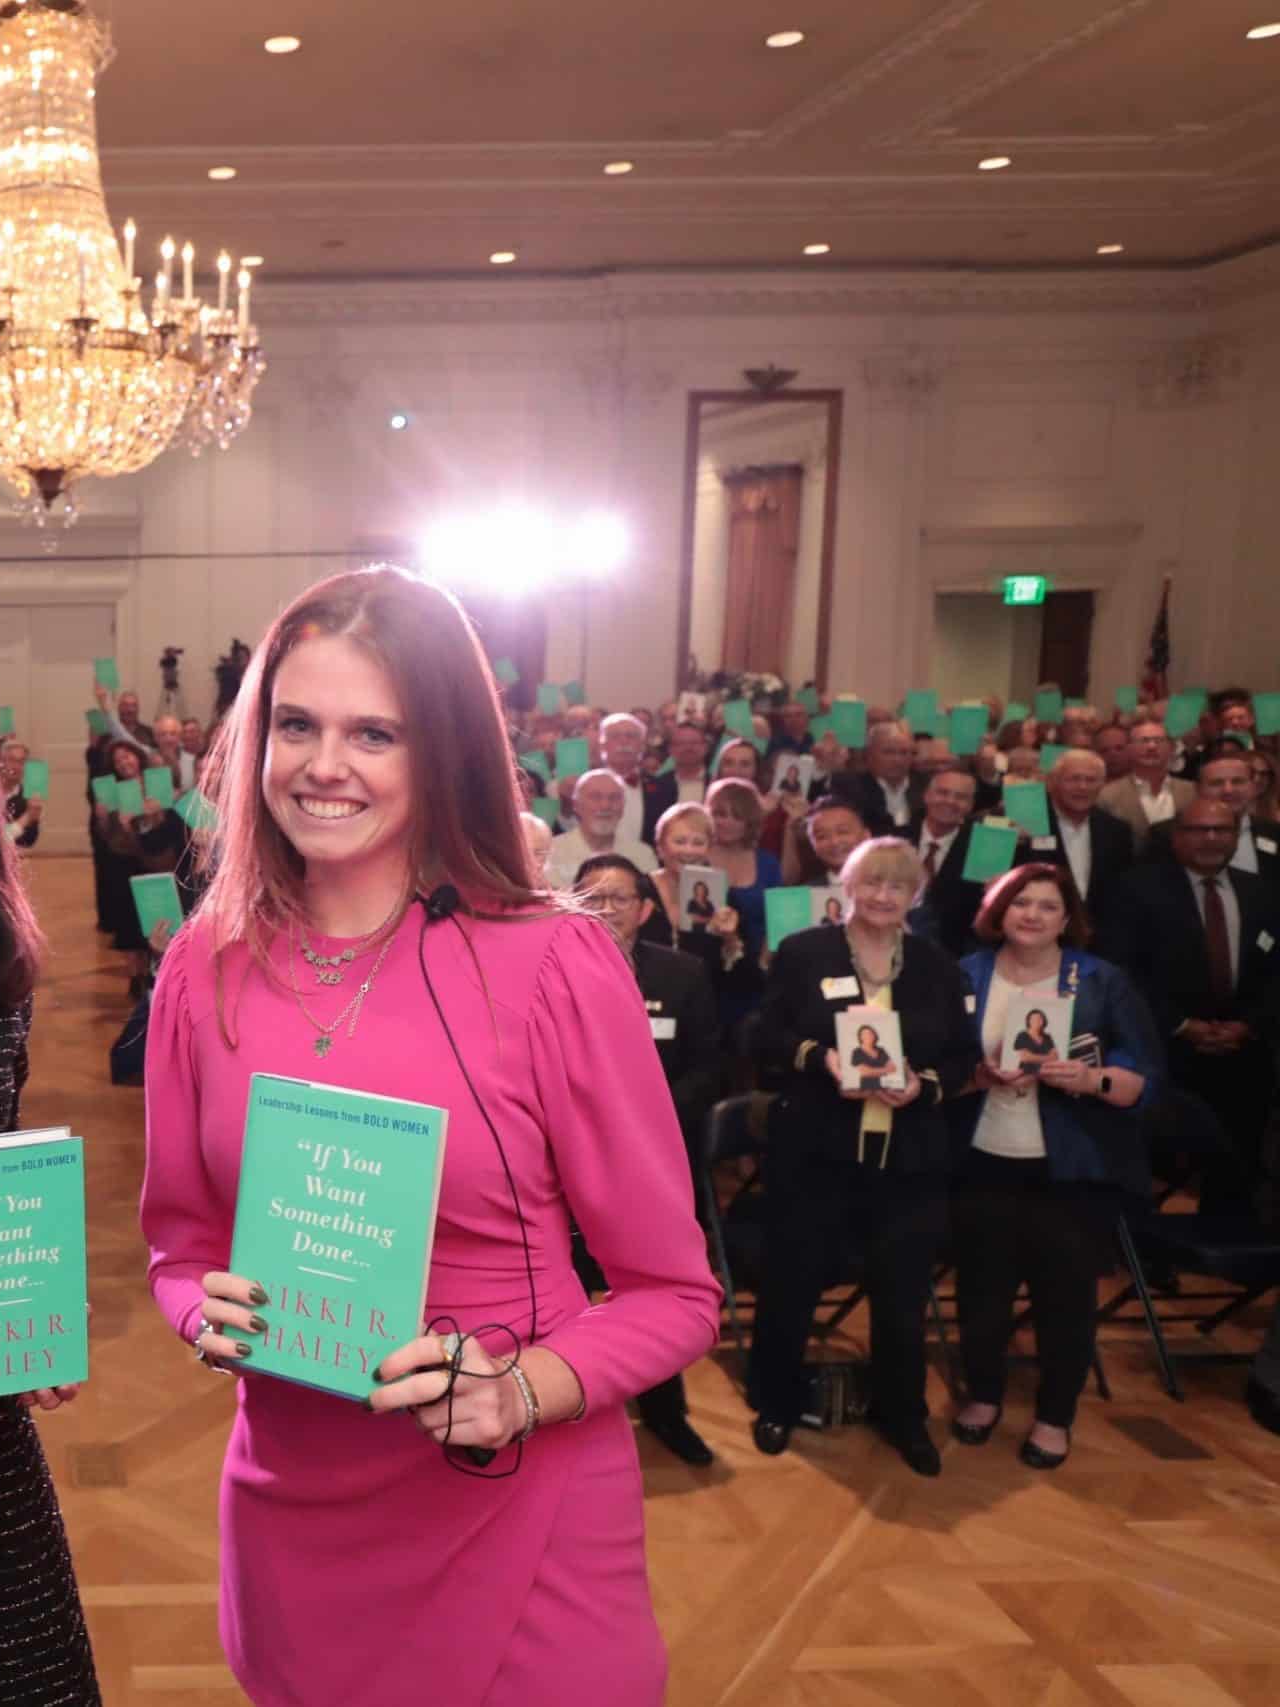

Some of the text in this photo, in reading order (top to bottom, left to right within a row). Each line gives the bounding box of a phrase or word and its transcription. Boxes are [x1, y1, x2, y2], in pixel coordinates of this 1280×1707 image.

[259, 1095, 430, 1136] Leadership Lessons from BOLD WOMEN
[21, 1158, 45, 1172] BOLD
[46, 1154, 77, 1168] WOMEN
[342, 1148, 383, 1177] You
[6, 1194, 43, 1214] You
[305, 1174, 367, 1208] Want
[267, 1197, 396, 1249] Something
[48, 1313, 73, 1336] R.
[368, 1308, 397, 1342] R.
[263, 1327, 376, 1374] HALEY
